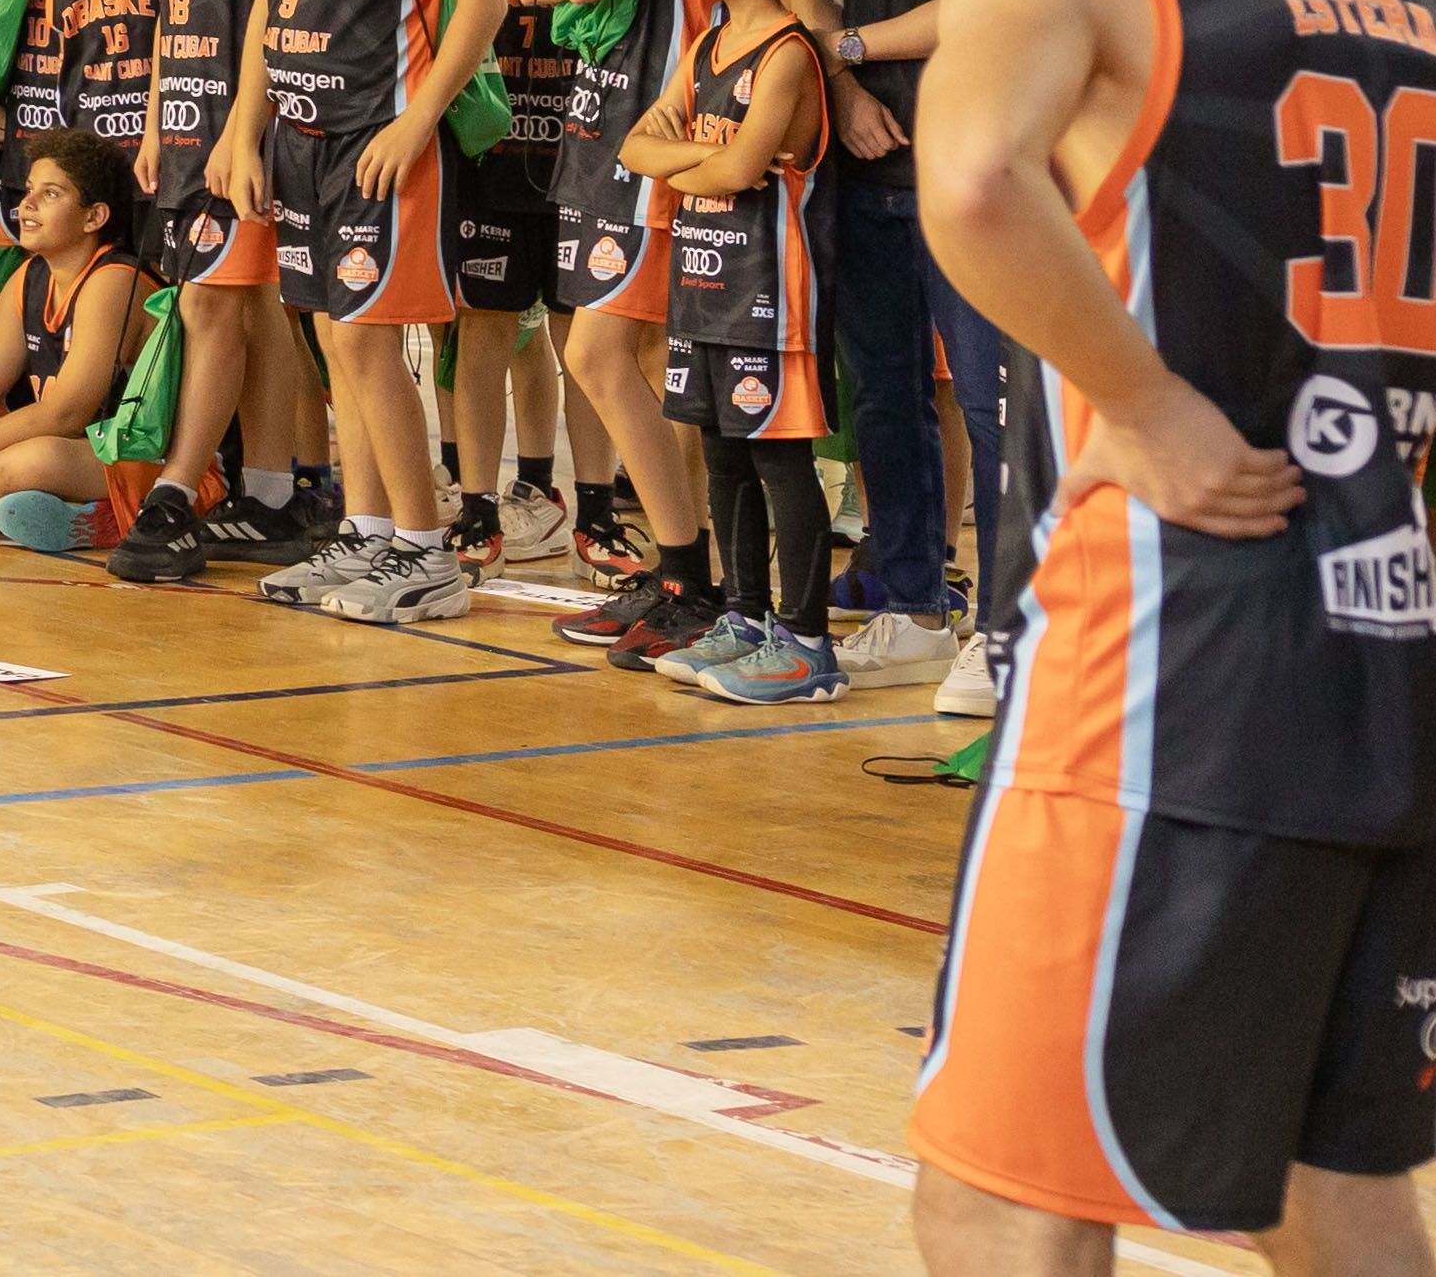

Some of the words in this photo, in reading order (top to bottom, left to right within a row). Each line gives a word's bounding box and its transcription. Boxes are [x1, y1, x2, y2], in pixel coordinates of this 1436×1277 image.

[27, 16, 52, 47] 10
[100, 22, 130, 56] 16
[281, 27, 332, 54] CUGAT
[518, 15, 535, 49] 7
[174, 35, 219, 60] CUGAT
[83, 62, 113, 81] SANT
[173, 134, 202, 147] Sport
[613, 163, 630, 182] M
[284, 207, 311, 225] KERN
[1273, 70, 1436, 357] 30
[355, 224, 380, 234] MARC
[605, 222, 630, 234] MART
[354, 234, 379, 243] MART
[751, 305, 775, 319] 3XS
[743, 356, 769, 364] MARC
[743, 364, 769, 372] MART
